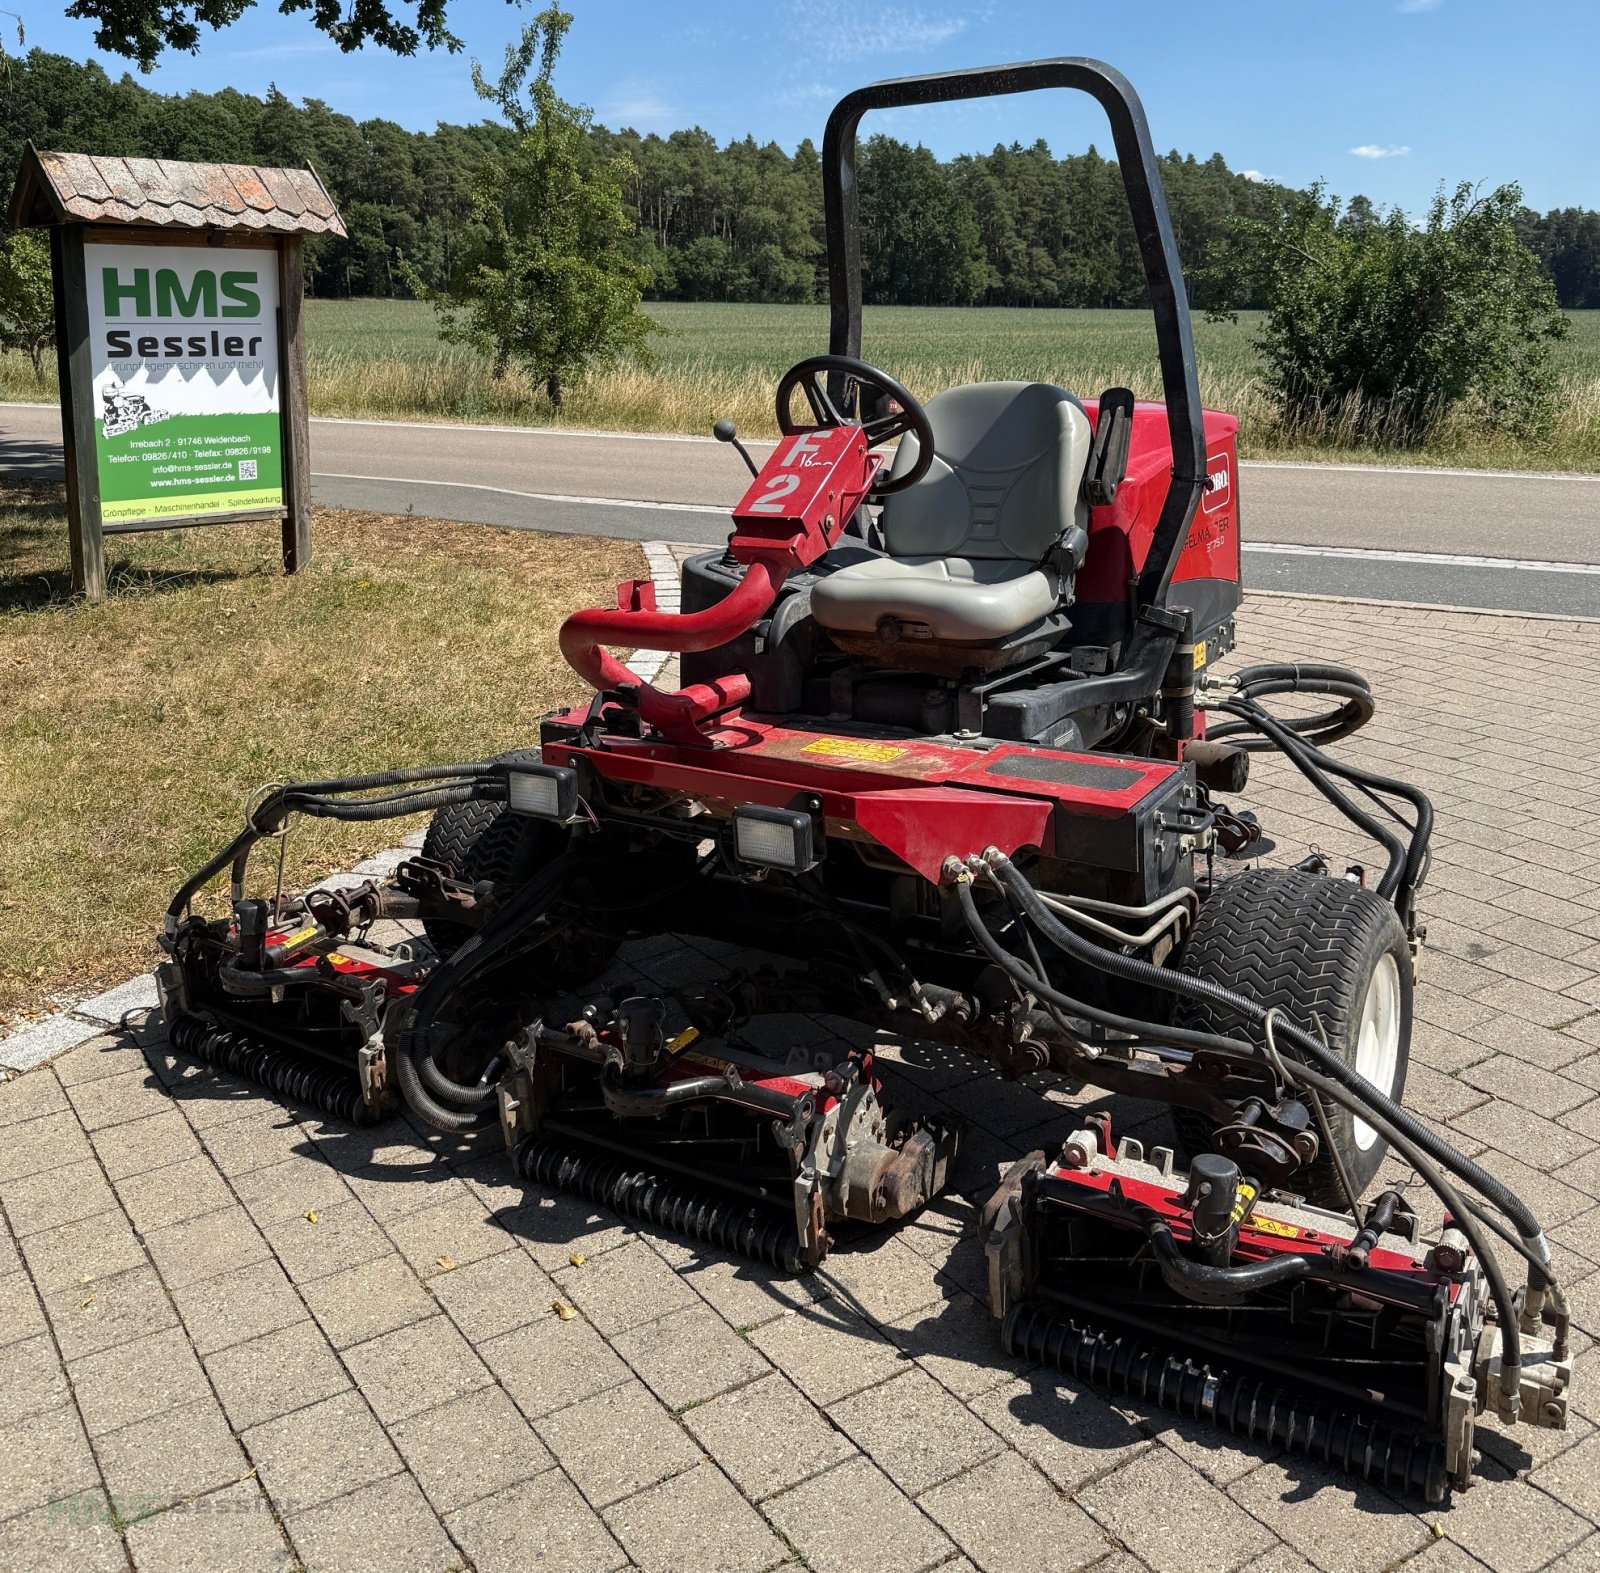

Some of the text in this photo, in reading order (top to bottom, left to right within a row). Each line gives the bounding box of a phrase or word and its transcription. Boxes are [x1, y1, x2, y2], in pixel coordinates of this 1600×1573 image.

[102, 267, 261, 318] HMS
[106, 330, 263, 358] Sessler
[108, 359, 264, 372] Grünpfegemschinen und mehr!
[130, 434, 251, 449] Irrebach 2 91746 Weidenbach
[780, 431, 834, 467] F
[107, 446, 272, 464] Telefon: 09826/410 Telefax: 09826/9198
[152, 462, 233, 474] info@hms-sessler.de
[150, 473, 236, 487] www.hms-sessler.de
[748, 474, 800, 513] 2
[102, 495, 281, 519] Grünpflege Maschinenhandel Spindelwartung
